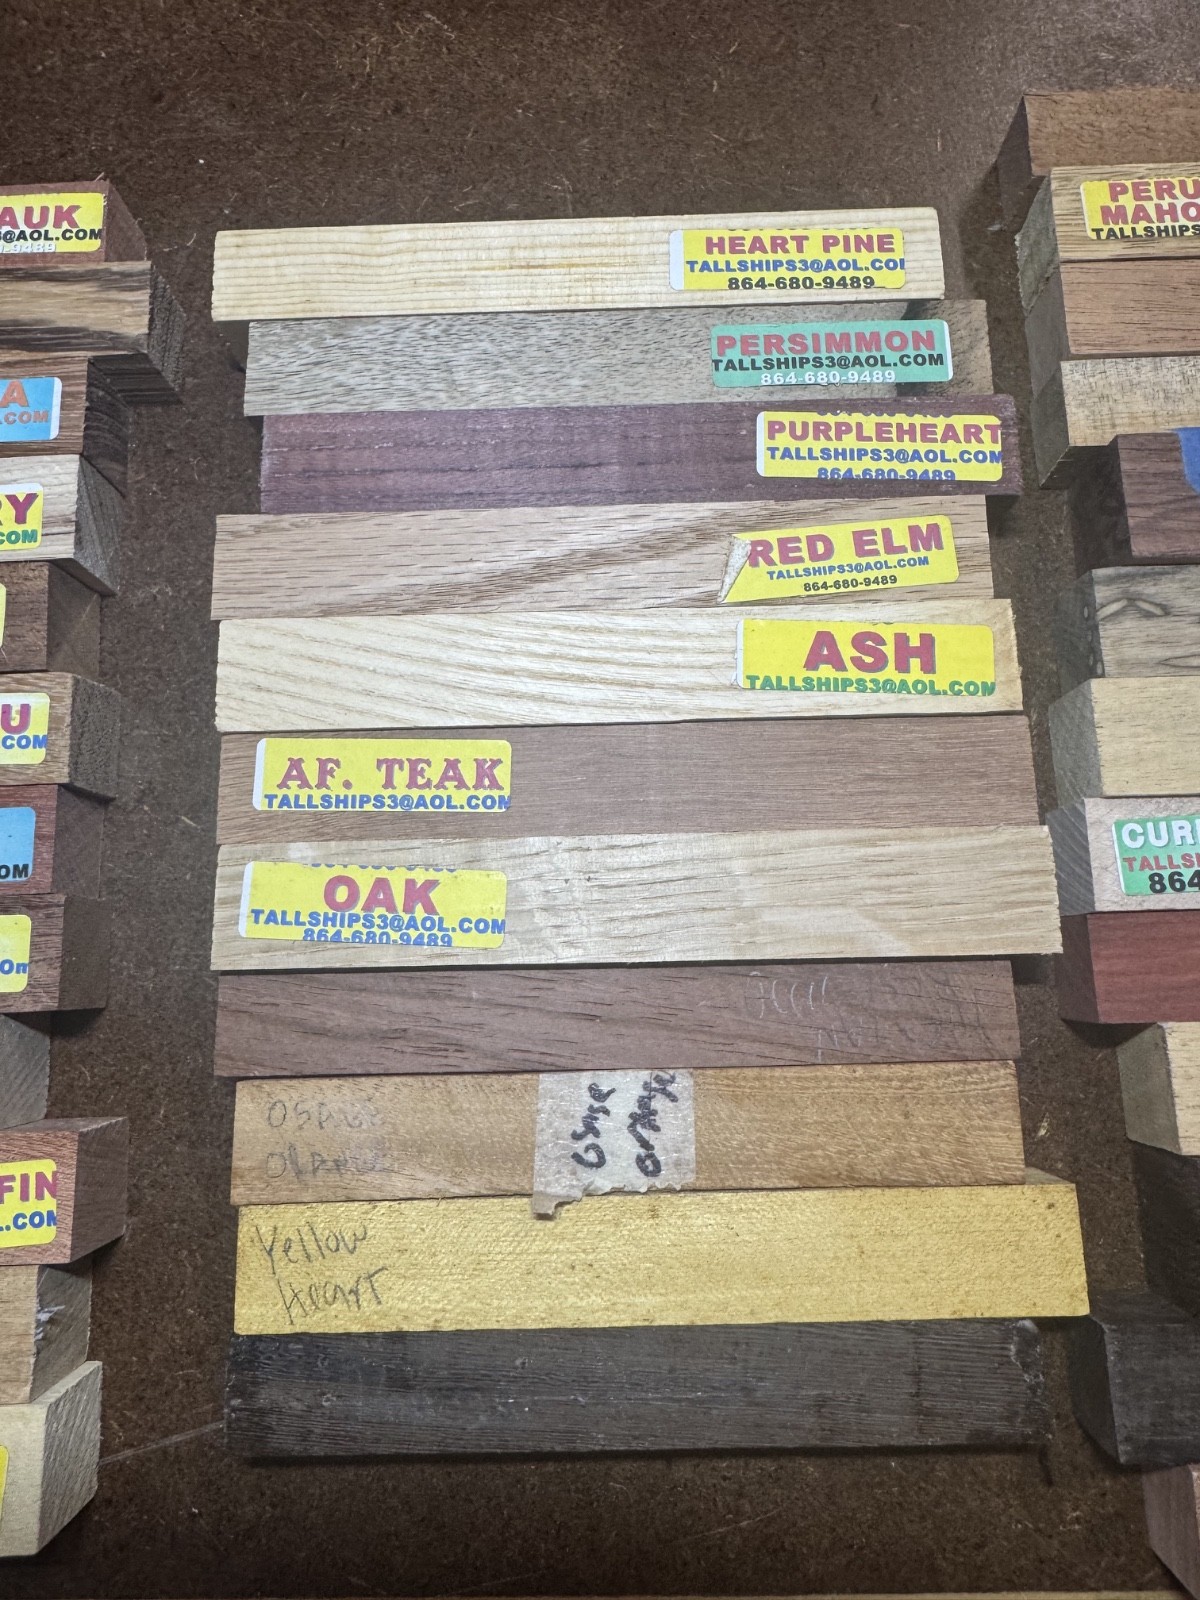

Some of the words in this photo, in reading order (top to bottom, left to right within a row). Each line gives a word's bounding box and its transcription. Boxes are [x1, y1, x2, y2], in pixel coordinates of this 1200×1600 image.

[1108, 178, 1200, 203] PERU
[1100, 201, 1200, 226] MAHO
[0, 228, 102, 244] @AOL.COM
[706, 235, 810, 255] HEART
[822, 233, 896, 254] PINE
[728, 275, 875, 291] 864-680-9489
[716, 330, 937, 357] PERSIMMON
[712, 353, 945, 372] TALLSHIPS3@AOL.COM
[760, 370, 897, 386] 864-680-9489
[766, 420, 1001, 445] PURPLEHEART
[817, 467, 957, 482] 864-680-9489
[0, 492, 39, 526] Y
[747, 534, 835, 568] RED
[852, 522, 944, 557] ELM
[766, 556, 930, 580] TALLSHIPS3@AOL.COM
[803, 575, 898, 593] 864-680-9489
[803, 630, 936, 675] ASH
[1, 703, 31, 735] U
[276, 757, 353, 792] AF.
[376, 757, 505, 791] TEAK
[1121, 818, 1200, 849] CUR
[323, 874, 441, 916] OAK
[251, 908, 506, 935] TALLSHIPS3@AOL.COM
[303, 928, 452, 947] 864-680-9489
[0, 1209, 57, 1231] .COM
[255, 1220, 368, 1275] Yellow
